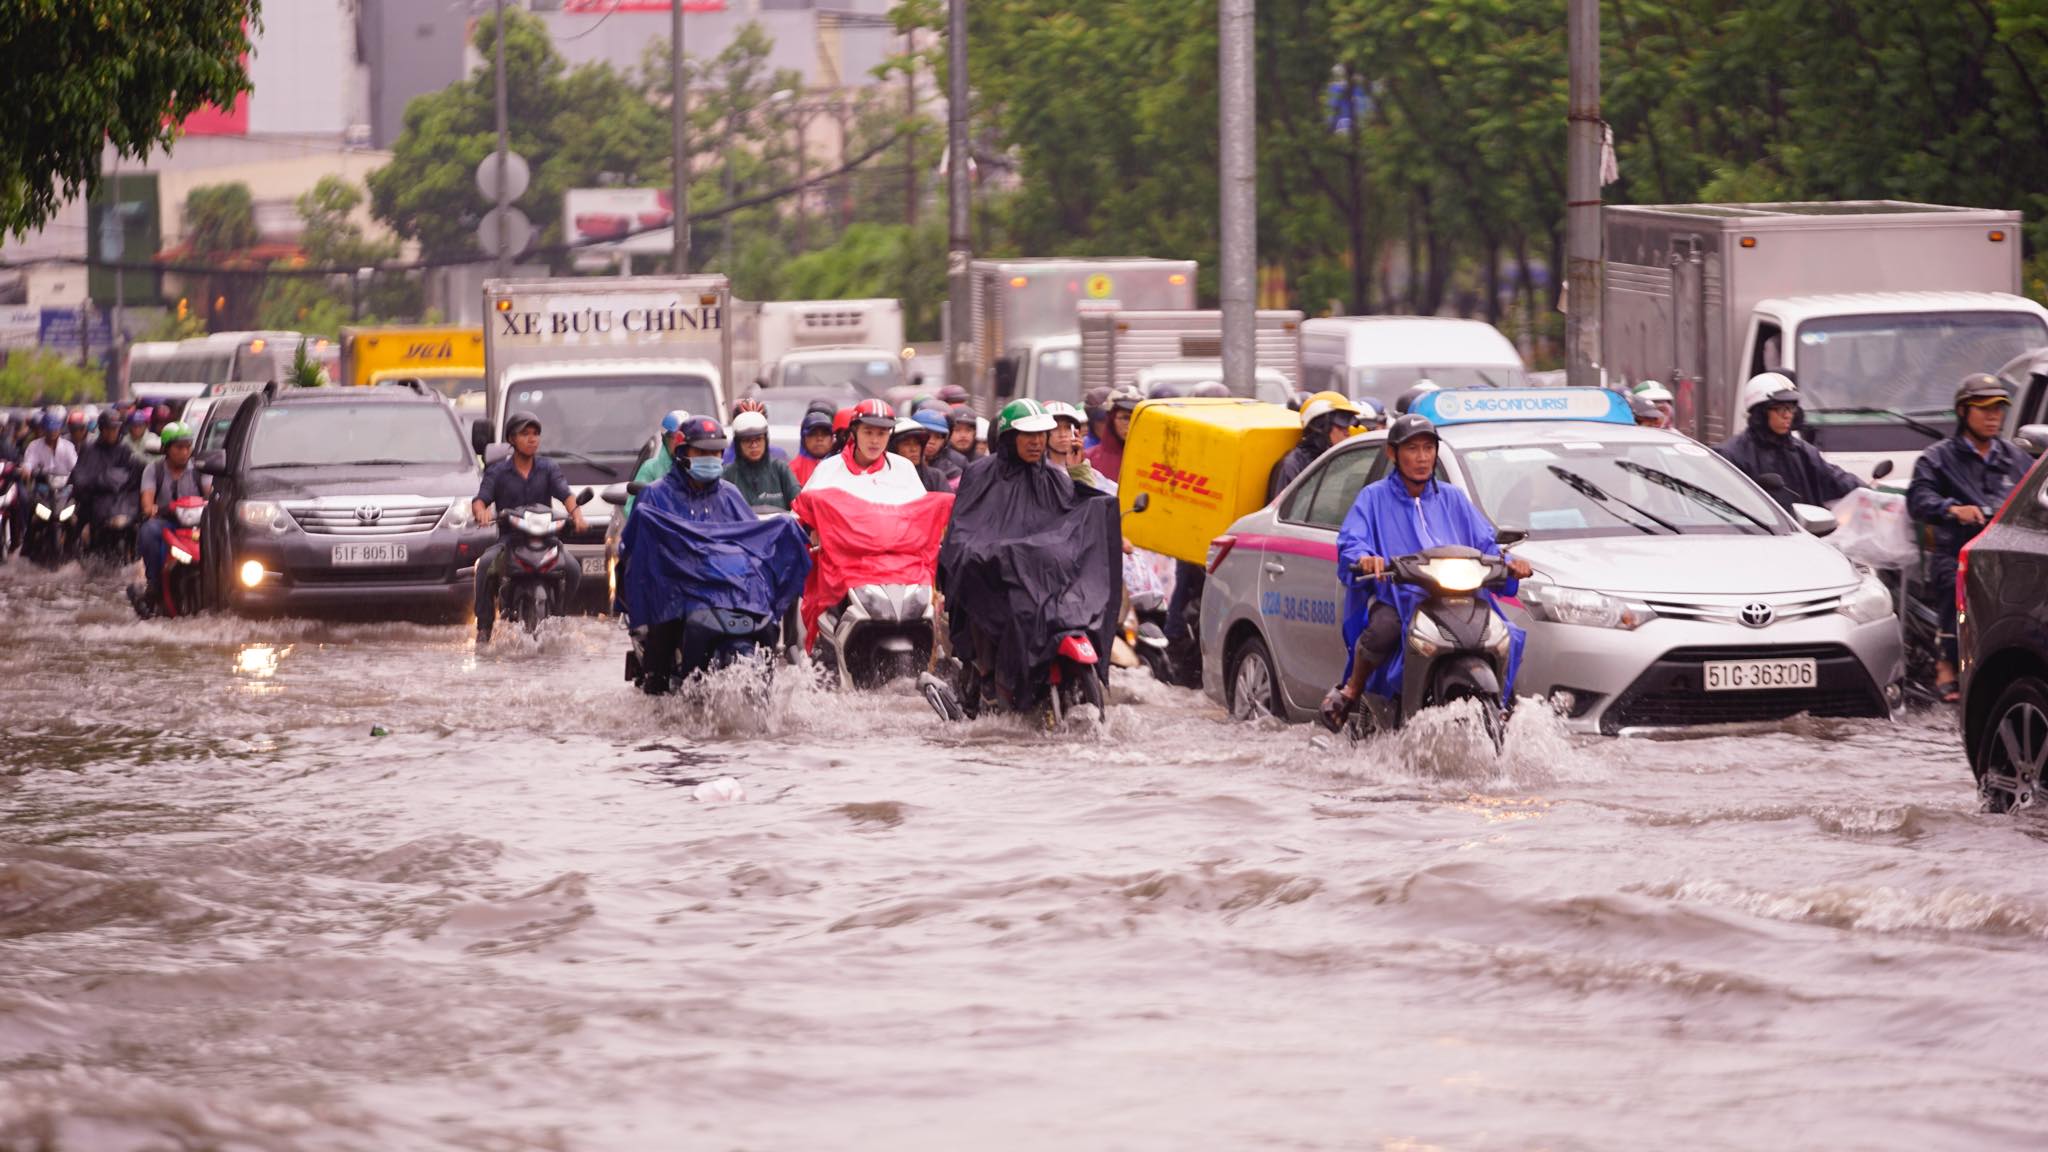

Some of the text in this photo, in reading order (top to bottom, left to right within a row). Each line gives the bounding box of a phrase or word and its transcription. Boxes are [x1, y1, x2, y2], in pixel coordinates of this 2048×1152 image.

[502, 301, 722, 335] XE BƯU CHÍNH
[1464, 398, 1568, 411] SAIGONTOURIST
[1150, 462, 1208, 495] DHL
